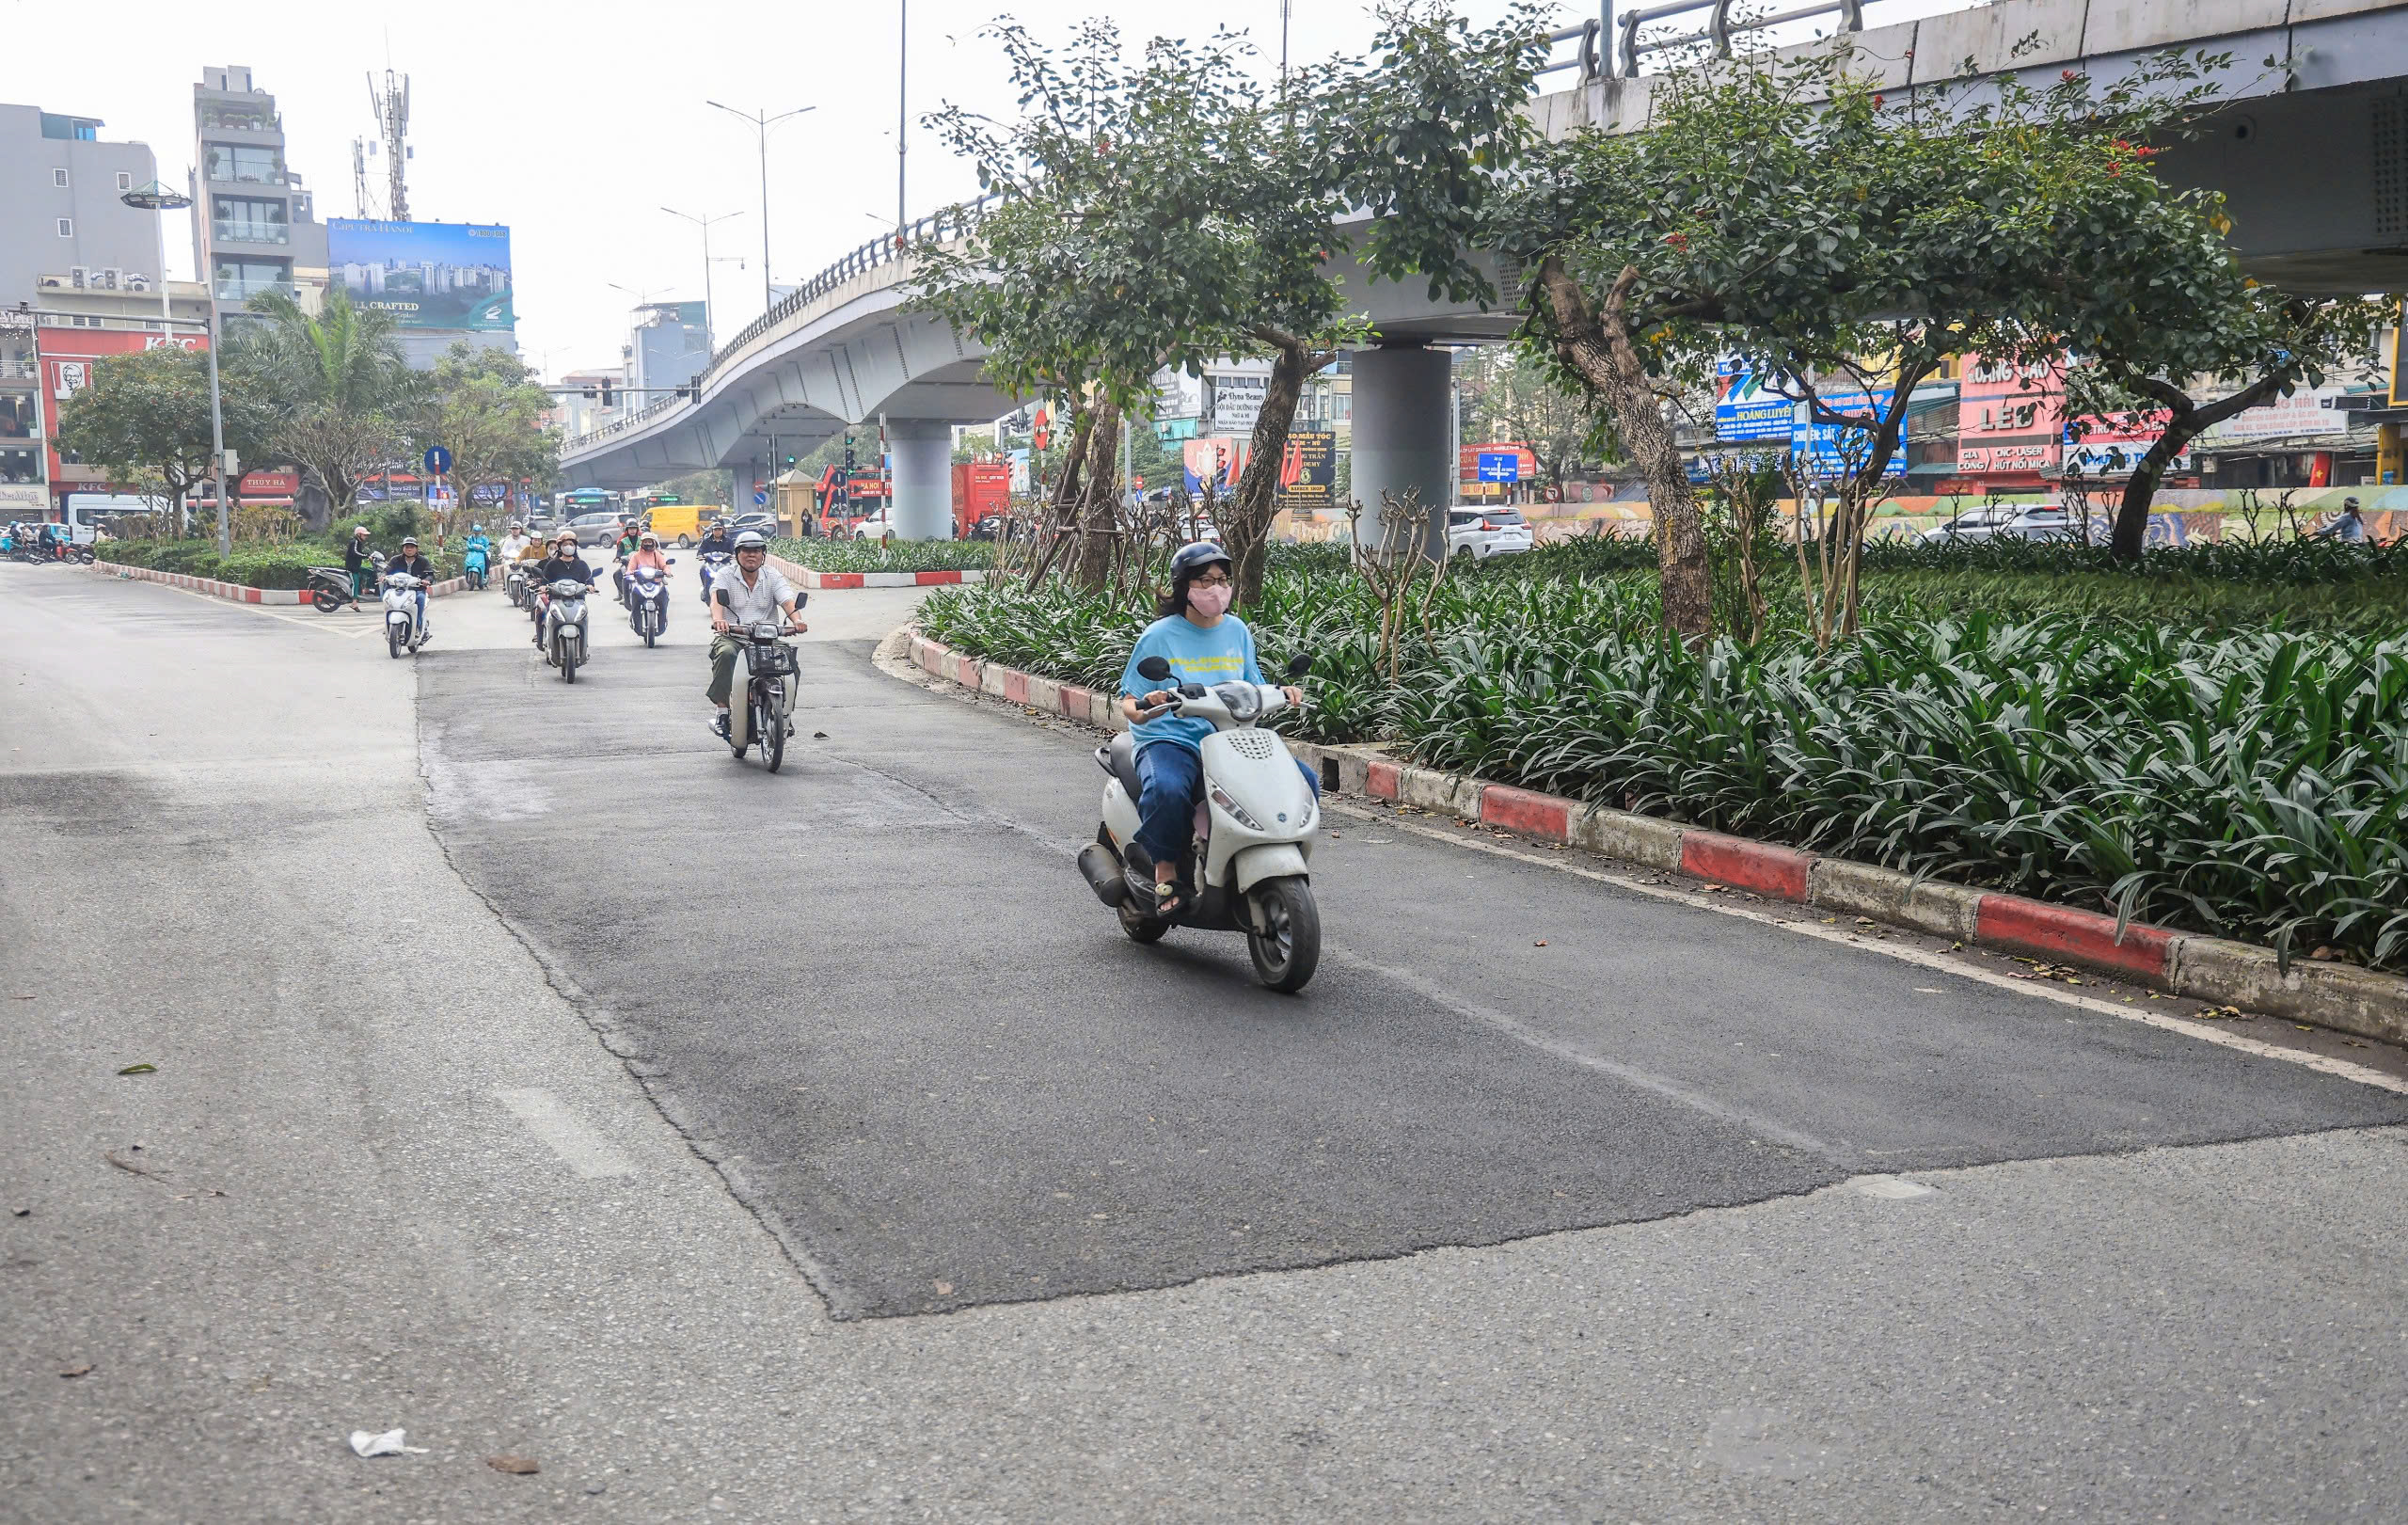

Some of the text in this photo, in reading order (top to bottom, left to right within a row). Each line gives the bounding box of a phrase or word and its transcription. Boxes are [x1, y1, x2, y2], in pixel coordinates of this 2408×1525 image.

[370, 301, 420, 311] CRAFTED
[1793, 426, 1821, 442] CHUÊN:
[1962, 451, 1978, 460] GIA
[2027, 459, 2052, 469] MICA
[77, 482, 106, 492] KFC
